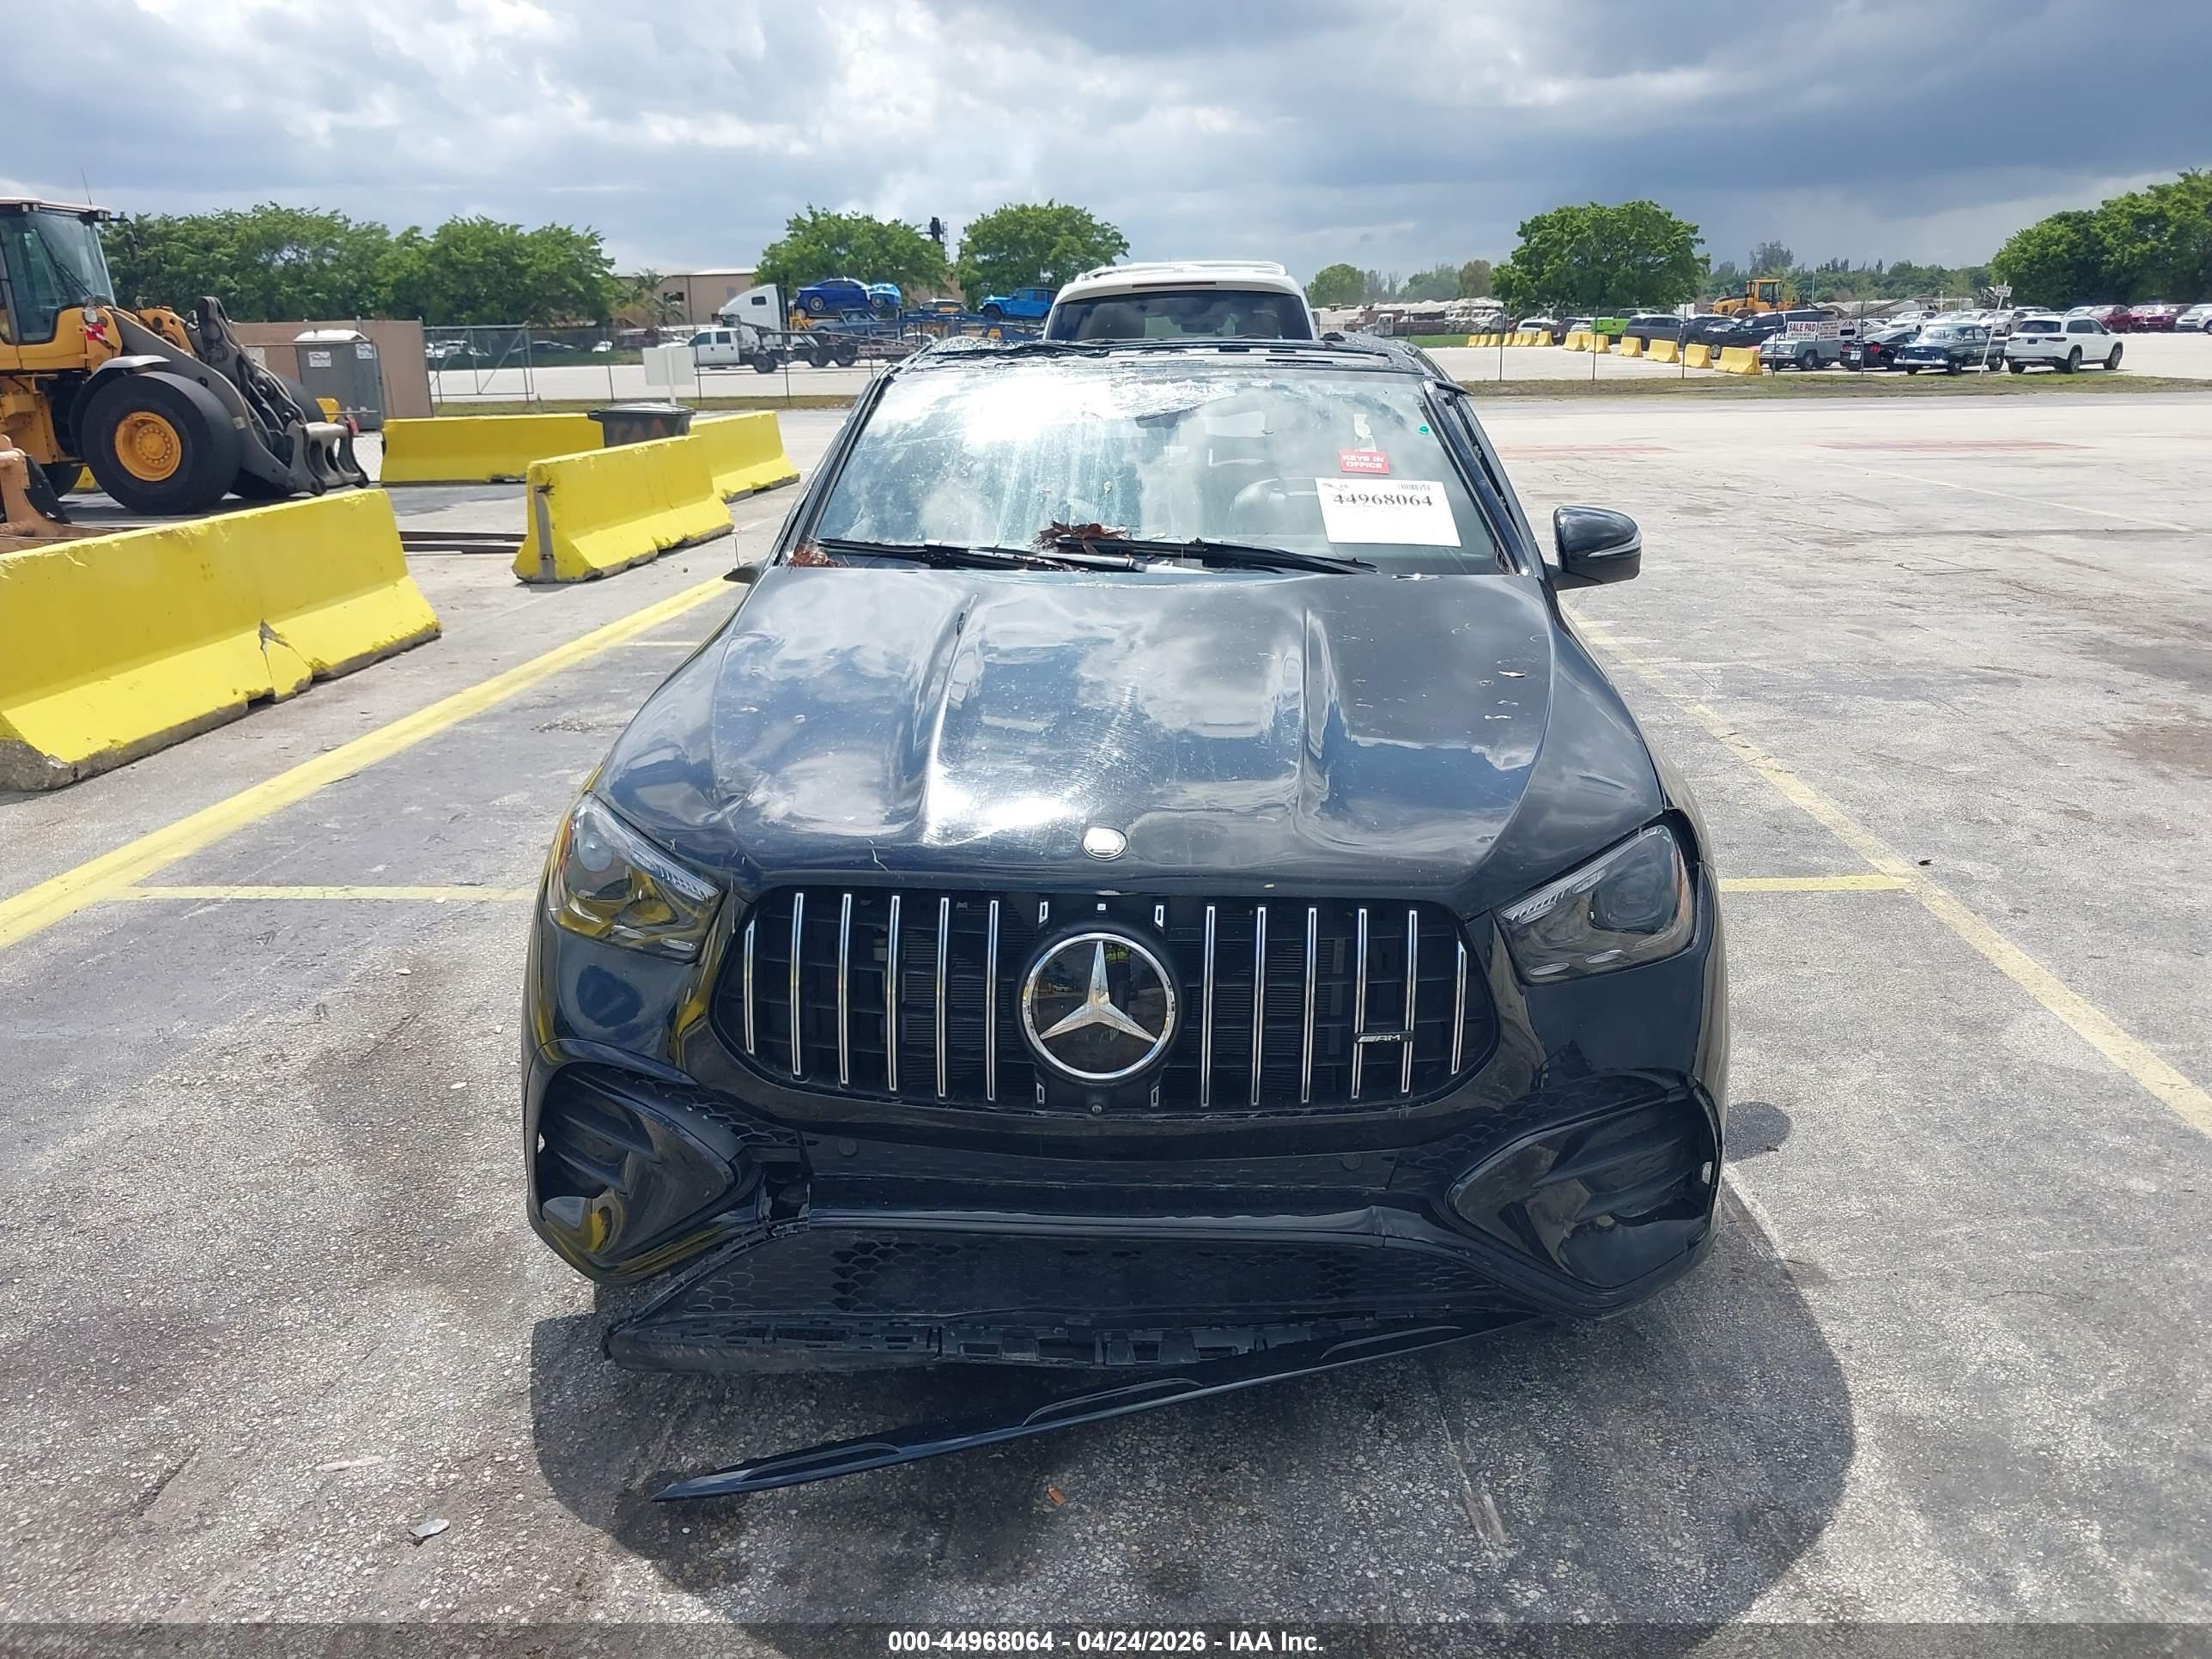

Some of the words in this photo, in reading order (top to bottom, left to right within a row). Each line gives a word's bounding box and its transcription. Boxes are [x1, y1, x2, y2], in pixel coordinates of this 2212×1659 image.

[1789, 323, 1803, 332] SALE
[1804, 323, 1816, 332] PAD
[1333, 493, 1433, 506] 44968064
